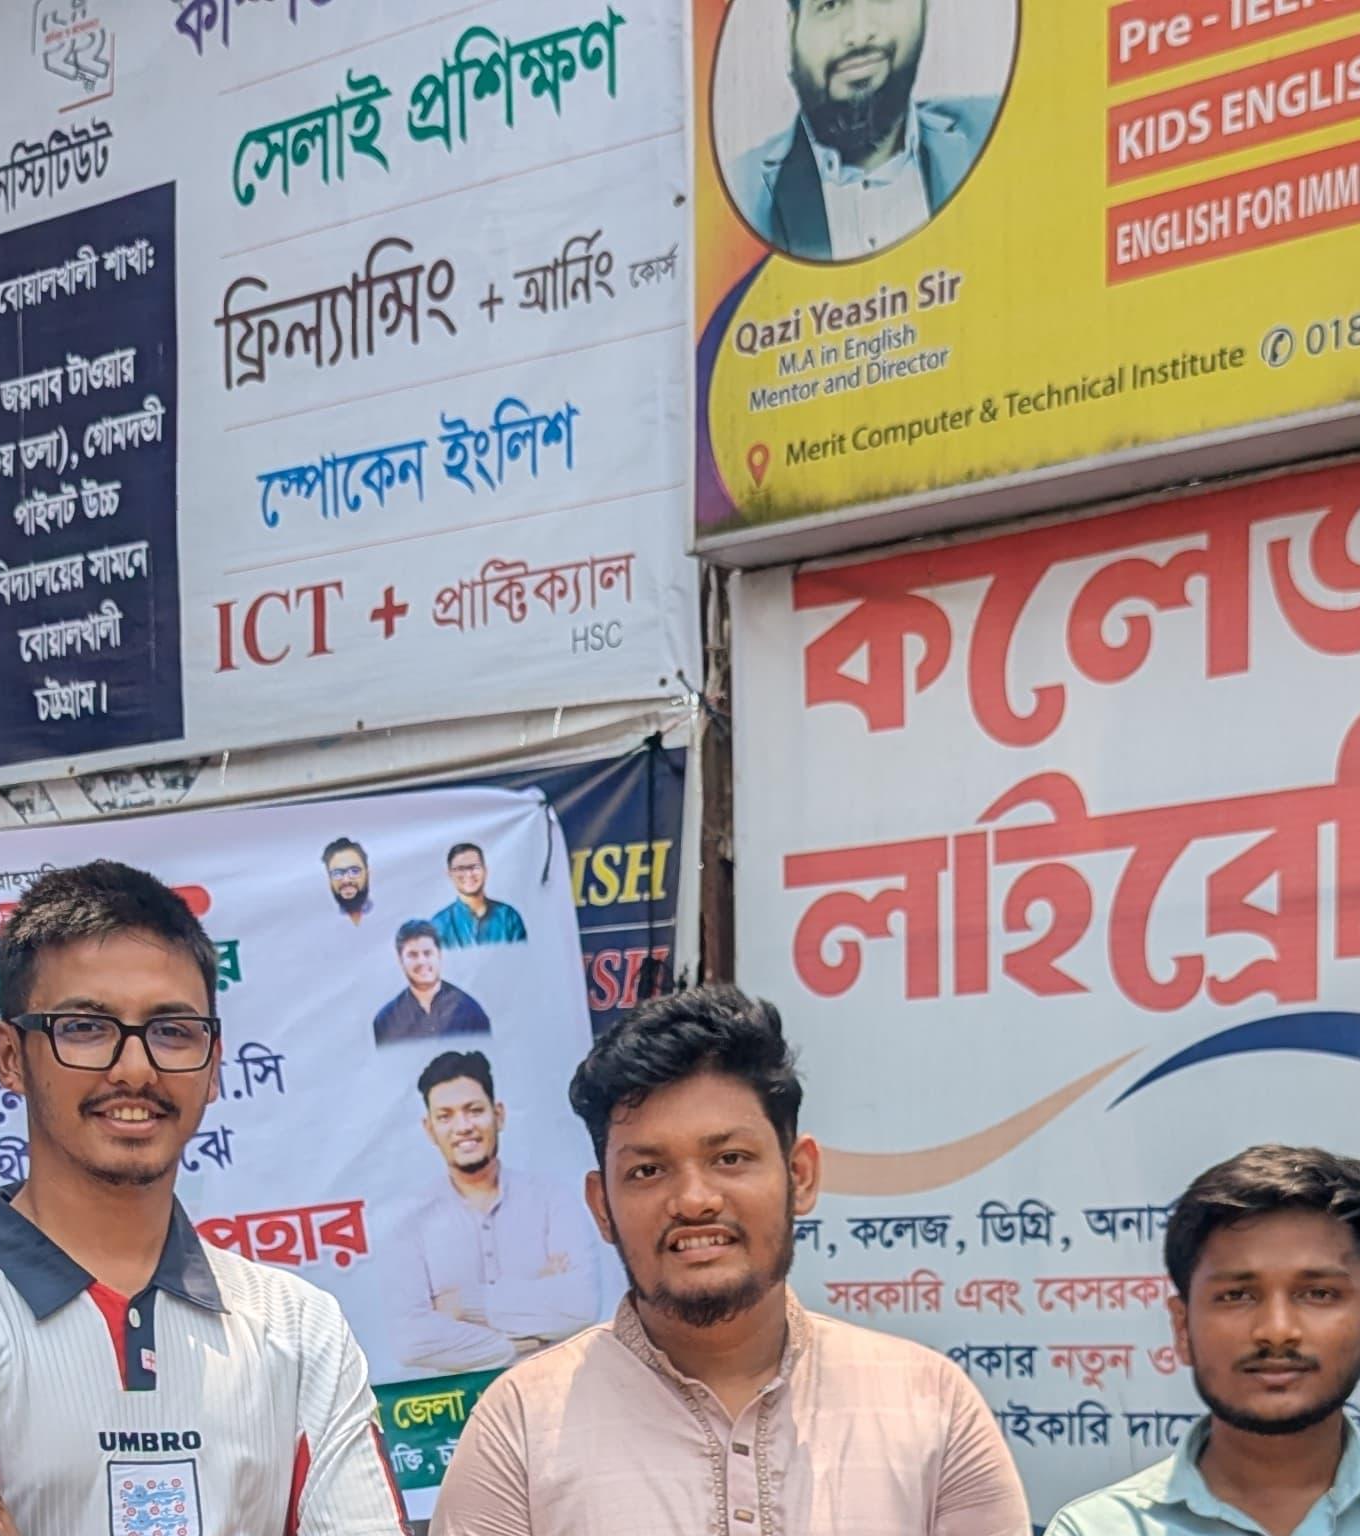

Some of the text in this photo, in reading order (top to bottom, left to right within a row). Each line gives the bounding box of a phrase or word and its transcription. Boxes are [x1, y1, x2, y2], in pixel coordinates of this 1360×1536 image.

[1118, 15, 1192, 65] Pre
[232, 5, 626, 206] সেলাই প্রশিক্ষণ
[1117, 112, 1212, 165] KIDS
[1115, 196, 1232, 267] ENGLISH
[1236, 181, 1293, 237] FOR
[512, 229, 615, 315] আর্নিং
[735, 269, 963, 357] Qazi Yeasin Sir
[821, 344, 838, 368] in
[843, 323, 916, 364] English
[748, 346, 950, 413] Mentor and Director
[784, 343, 1246, 467] Merit Computer & Technical Institute
[256, 396, 581, 529] স্পোকেন ইংলিশ
[14, 478, 122, 536] পাইলট উচ্চ
[87, 541, 150, 585] সামনে
[212, 580, 343, 674] ICT
[570, 621, 624, 656] HSC
[824, 1268, 943, 1313] সরকারি
[955, 1279, 1024, 1315] এবং
[1047, 1344, 1134, 1388] নতুন
[393, 1390, 465, 1430] জেলা
[99, 1430, 202, 1454] UMBRO
